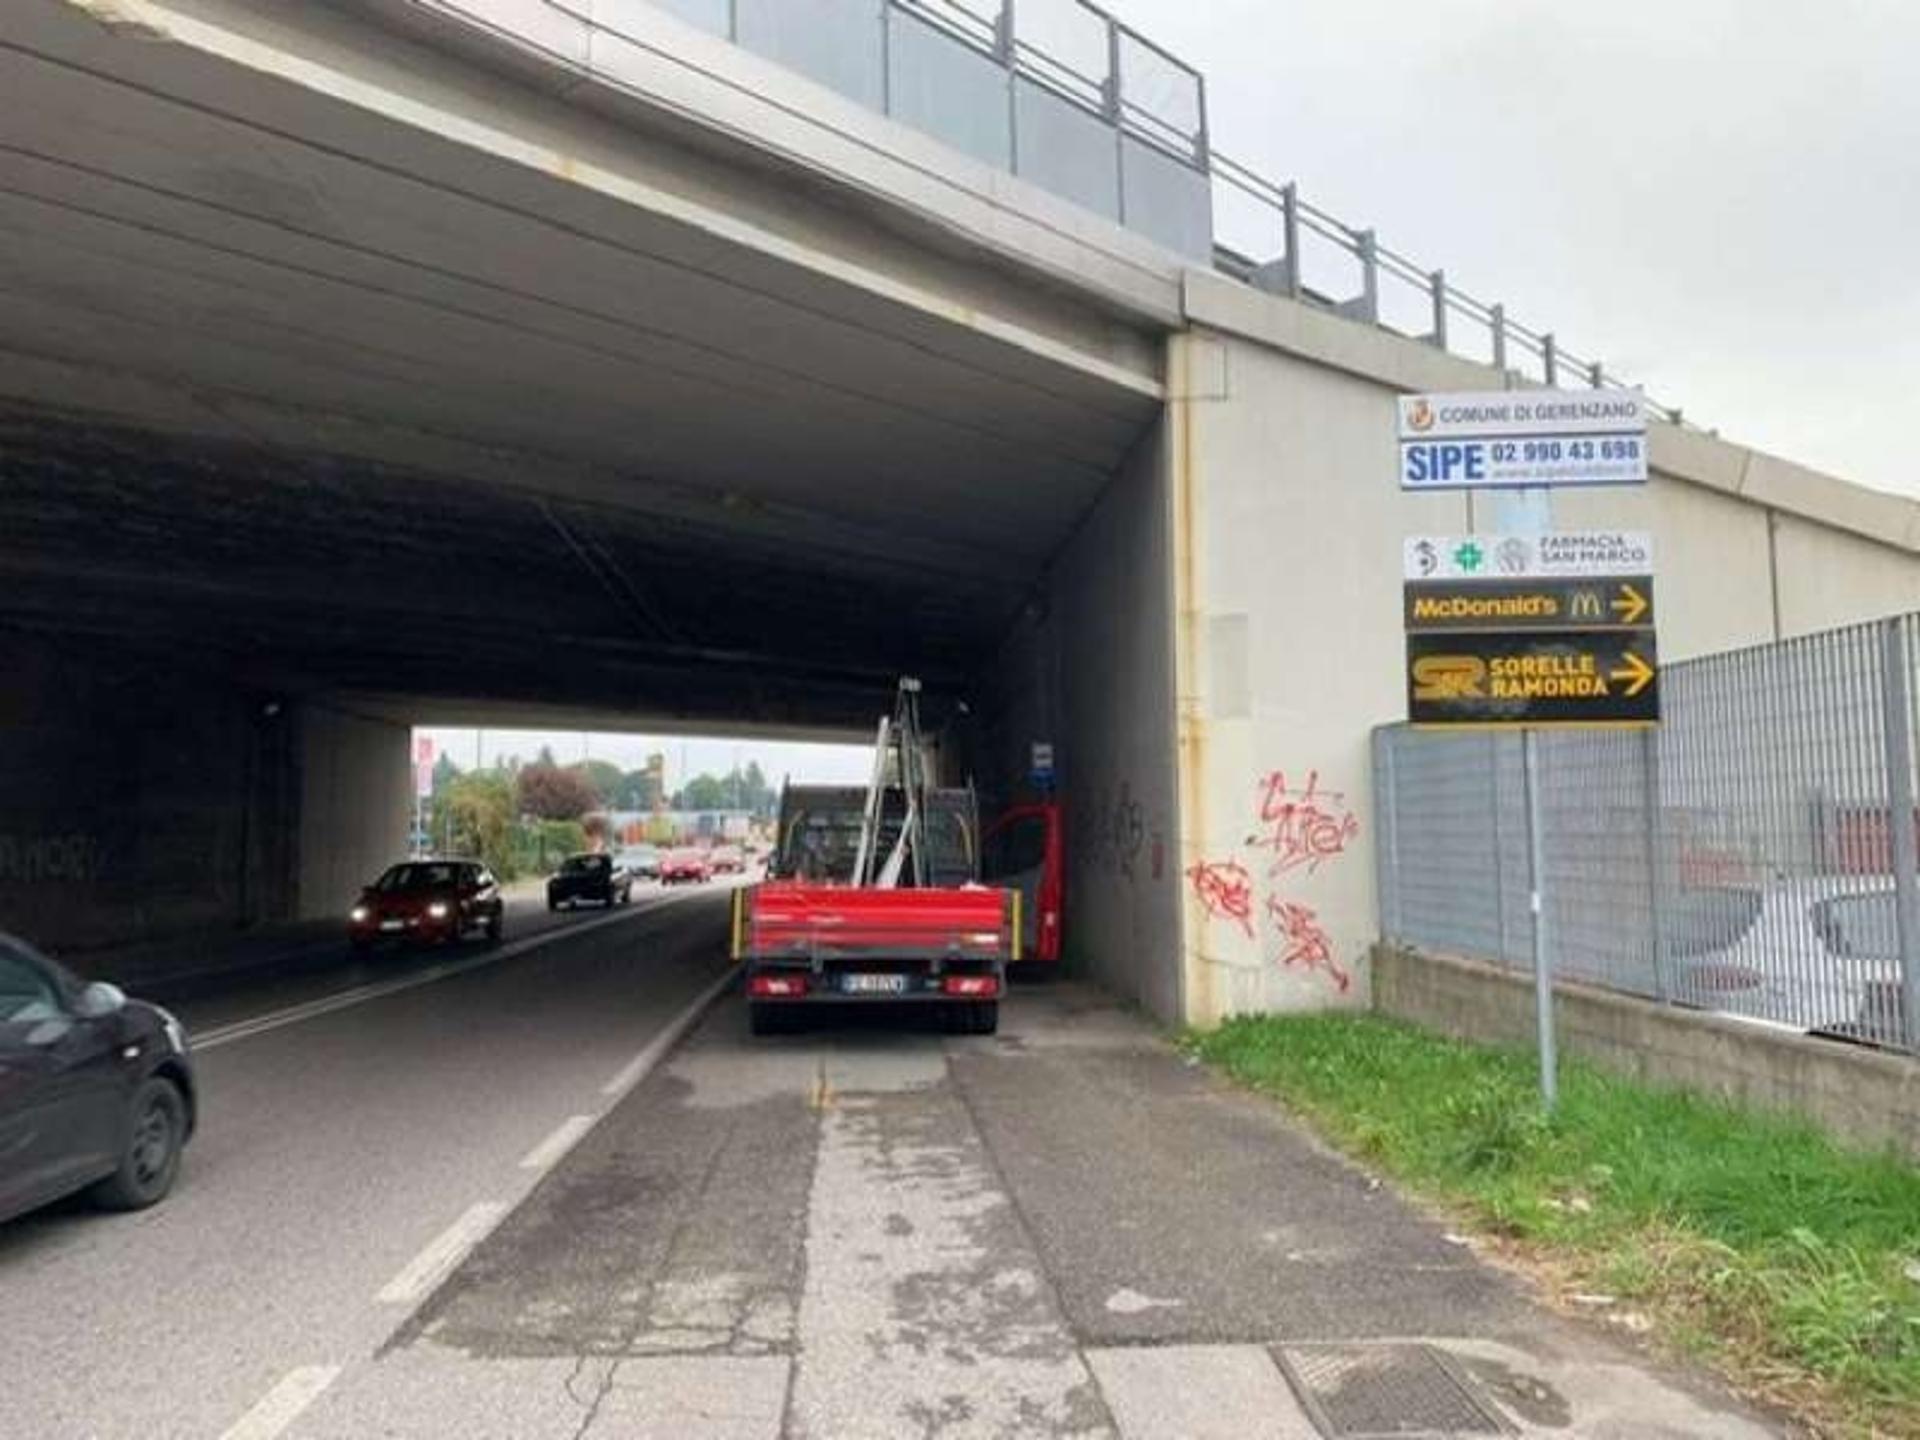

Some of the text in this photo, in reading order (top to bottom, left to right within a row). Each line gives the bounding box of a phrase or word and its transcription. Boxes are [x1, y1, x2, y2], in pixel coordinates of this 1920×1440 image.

[1439, 402, 1637, 423] COMUNE DI GERENZANO
[1491, 442, 1517, 462] 02
[1568, 440, 1595, 460] 43
[1406, 444, 1485, 481] SIPE
[1540, 535, 1624, 549] FARMACIA
[1541, 548, 1645, 564] SAN MARCO
[1414, 595, 1557, 617] McDonald's
[1489, 655, 1596, 677] SORELLE
[1490, 675, 1609, 698] RAMONDA
